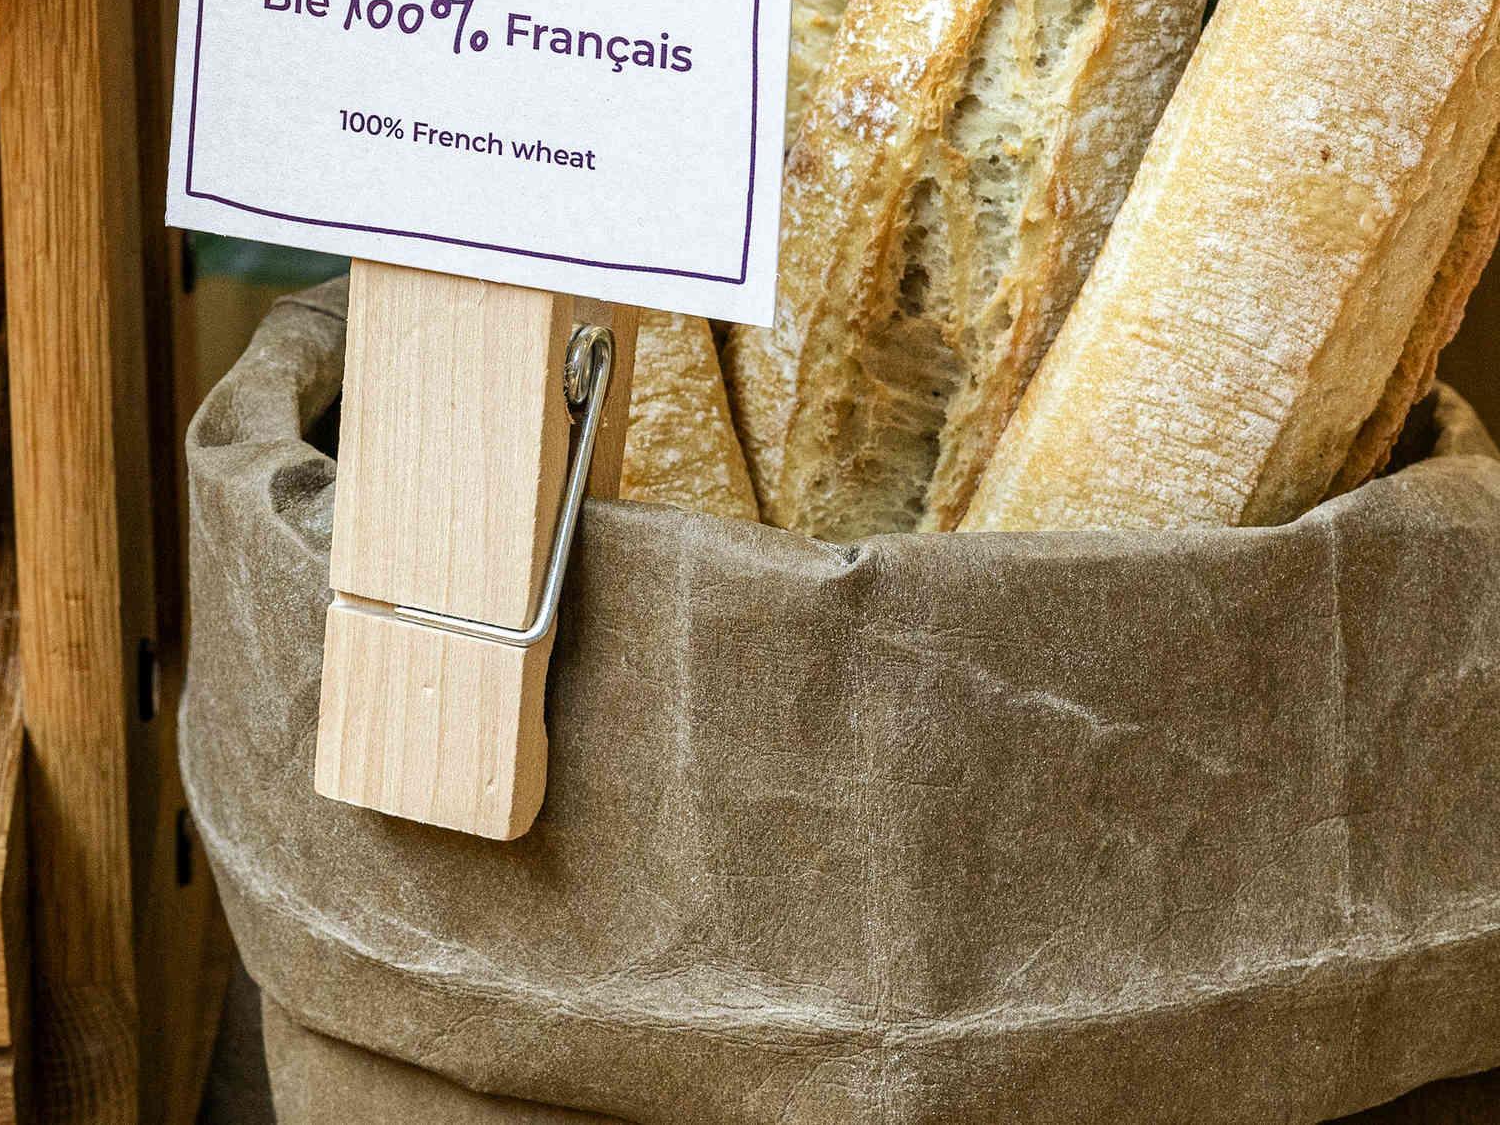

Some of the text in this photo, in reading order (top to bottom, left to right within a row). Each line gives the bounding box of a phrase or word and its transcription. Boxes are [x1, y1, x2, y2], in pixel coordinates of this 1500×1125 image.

[507, 13, 692, 72] Français
[340, 110, 595, 170] 100% French wheat
